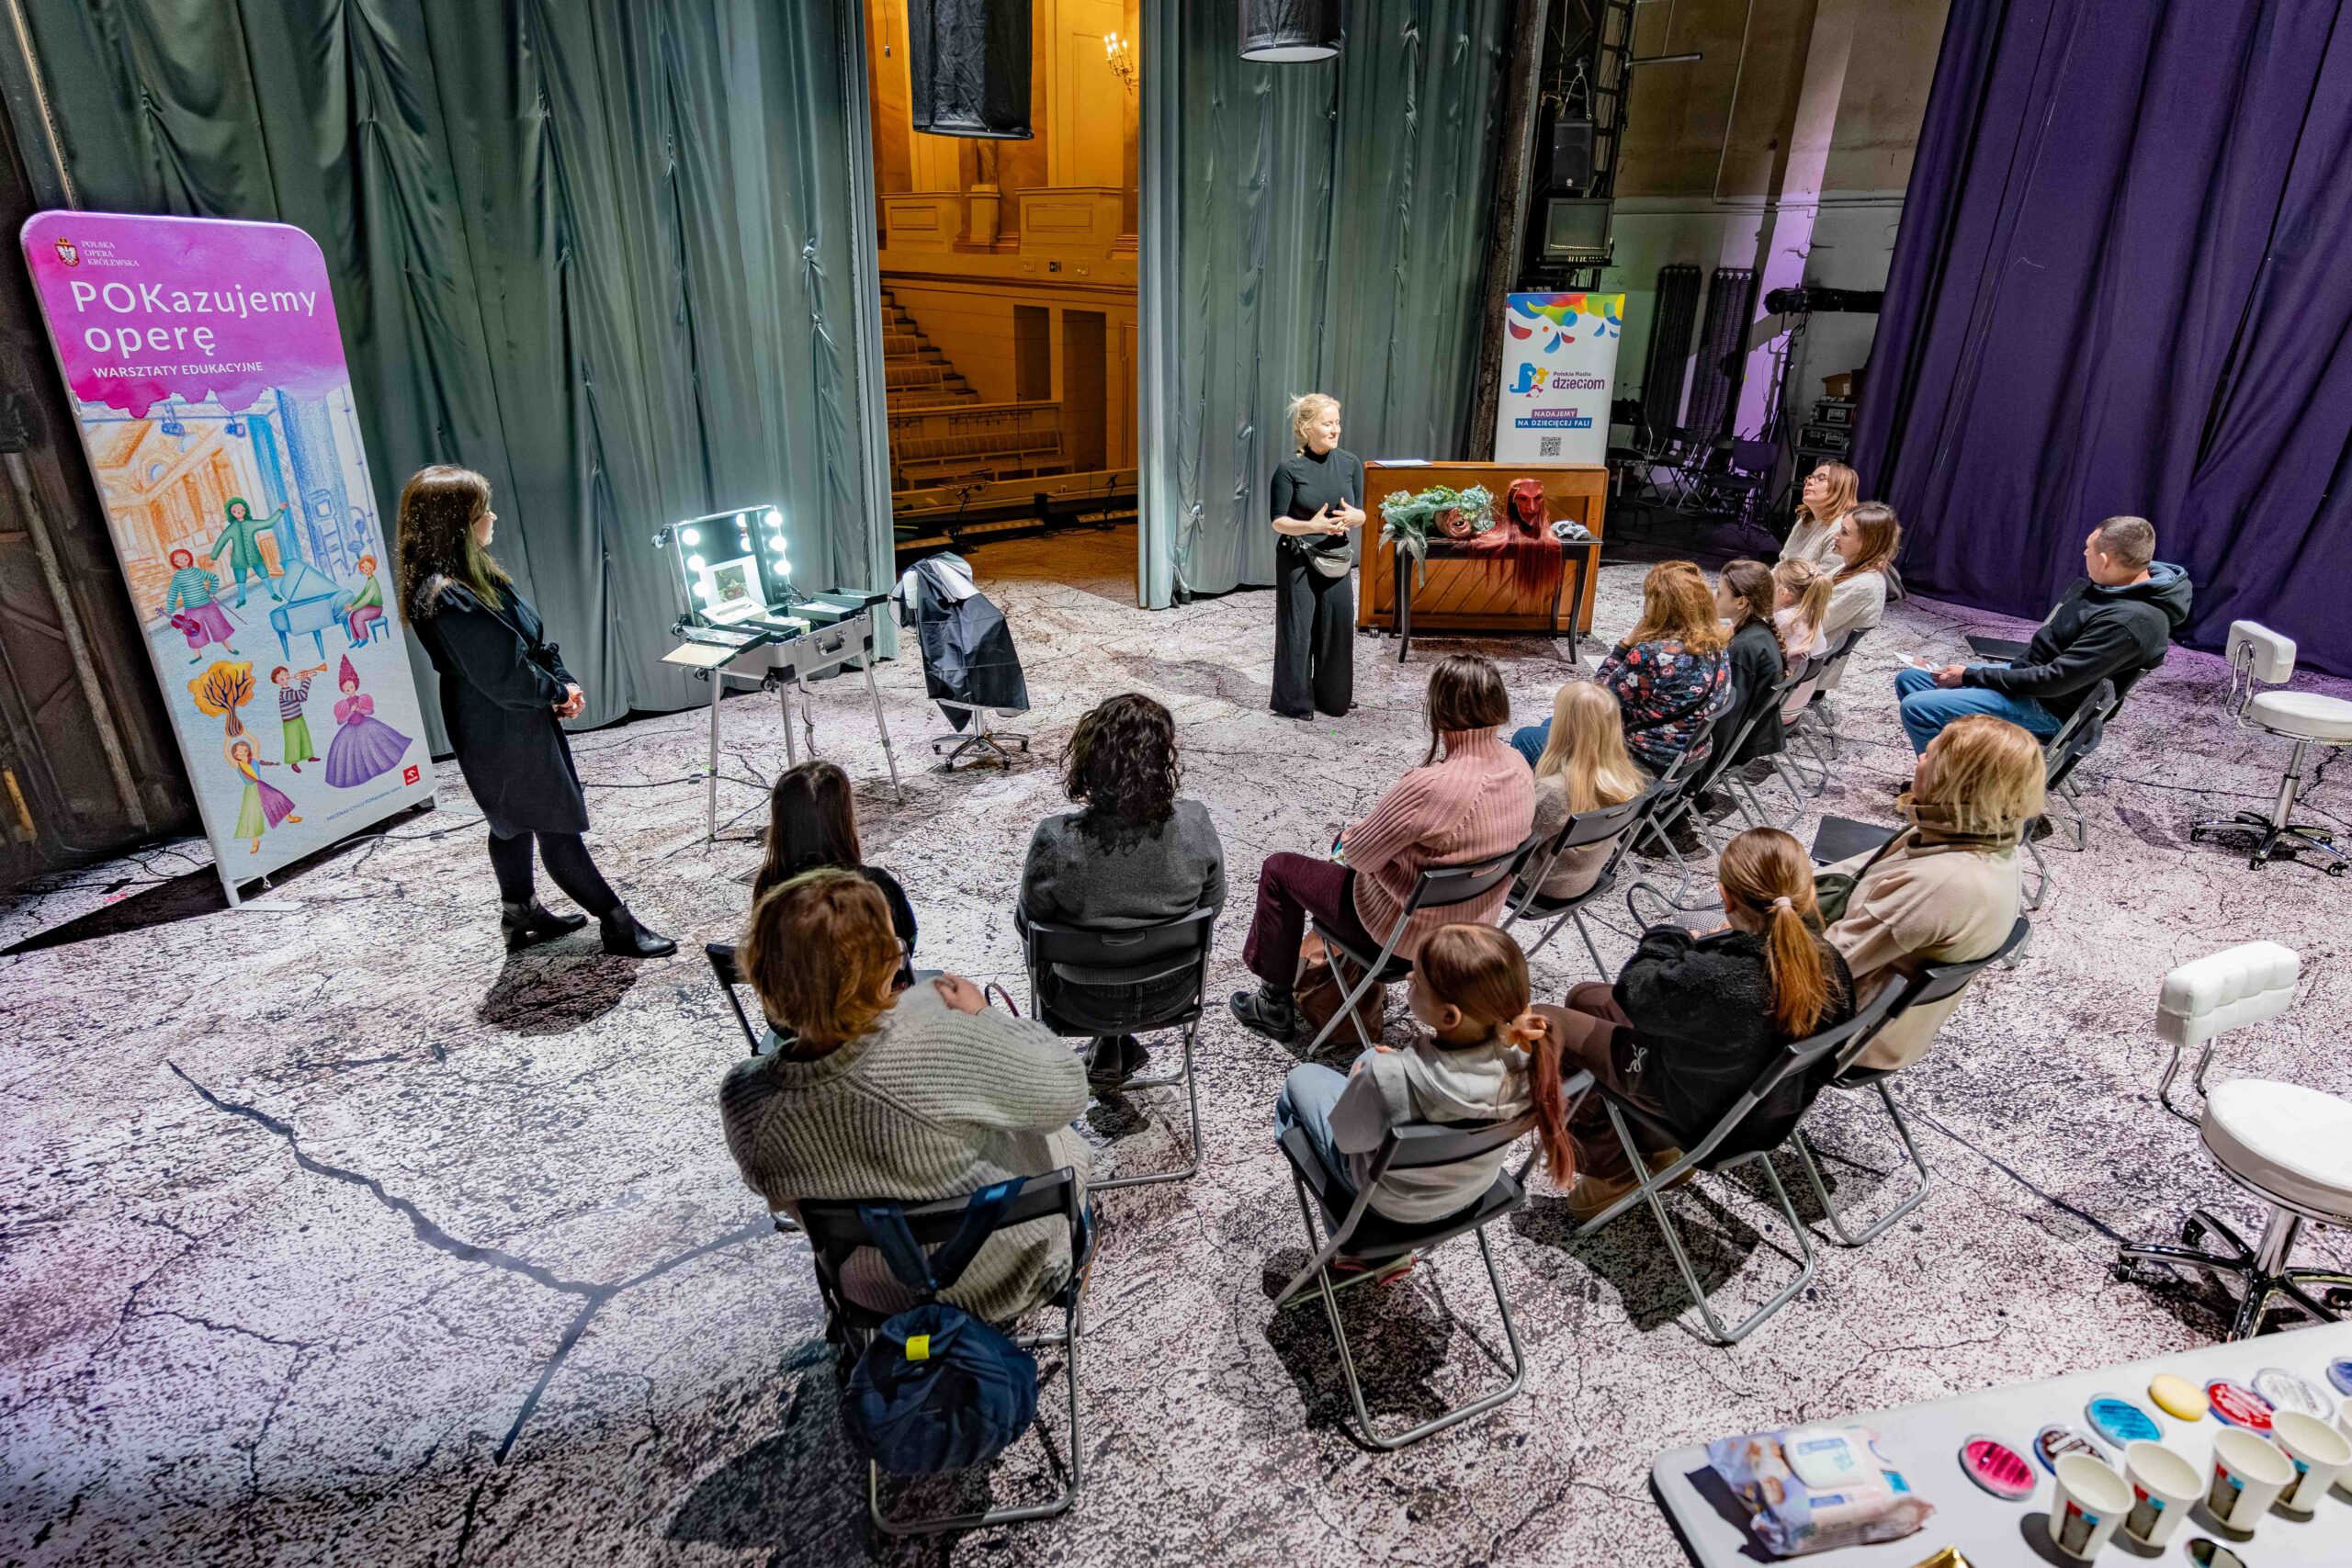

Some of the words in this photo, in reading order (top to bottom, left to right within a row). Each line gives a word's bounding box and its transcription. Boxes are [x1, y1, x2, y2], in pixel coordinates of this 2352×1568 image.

[81, 240, 116, 249] POLSKA
[85, 250, 114, 258] OPERA
[87, 257, 140, 267] KRÓLEWSKA
[70, 280, 316, 318] POKazujemy
[85, 326, 216, 359] operę
[93, 365, 177, 378] WARSZTATY
[181, 361, 264, 376] EDUKACYJNE
[1552, 377, 1605, 389] dzieciom
[1531, 419, 1572, 428] DZIECIĘCEJ
